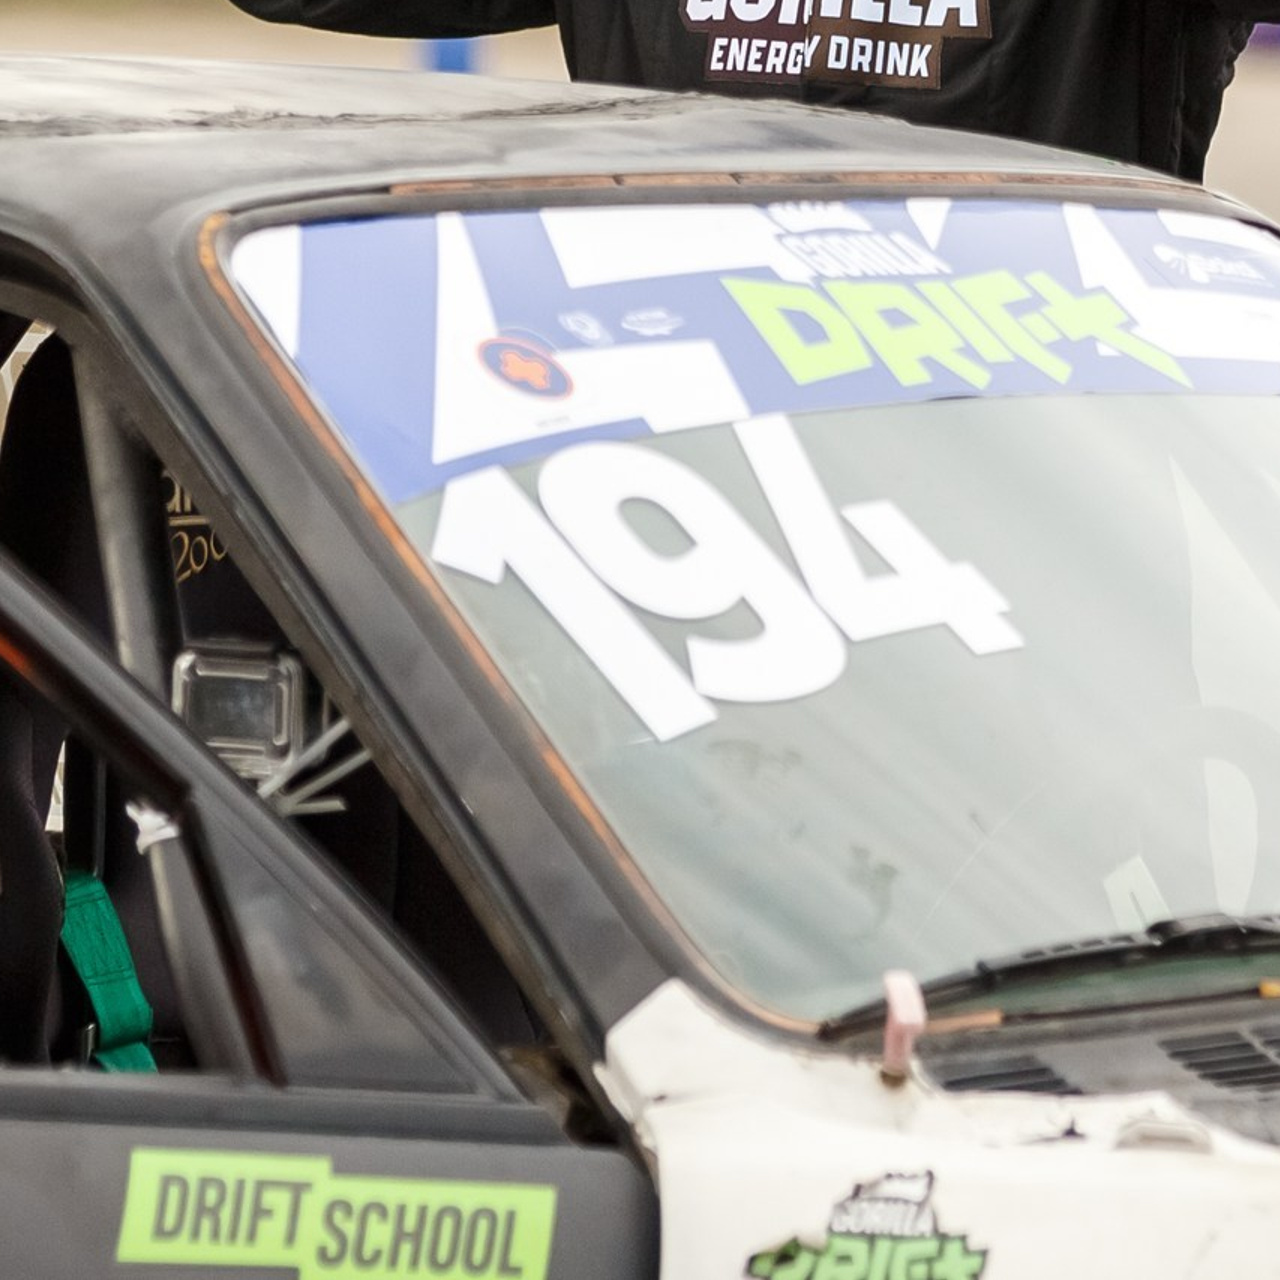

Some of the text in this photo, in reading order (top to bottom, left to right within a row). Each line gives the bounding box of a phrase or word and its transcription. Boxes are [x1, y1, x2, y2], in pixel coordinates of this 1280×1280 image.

[709, 34, 933, 78] ENERGY DRINK
[780, 230, 953, 278] GORILLA
[719, 269, 1195, 390] DRIFT
[431, 412, 1025, 742] 194
[151, 1174, 524, 1277] DRIFT SCHOOL
